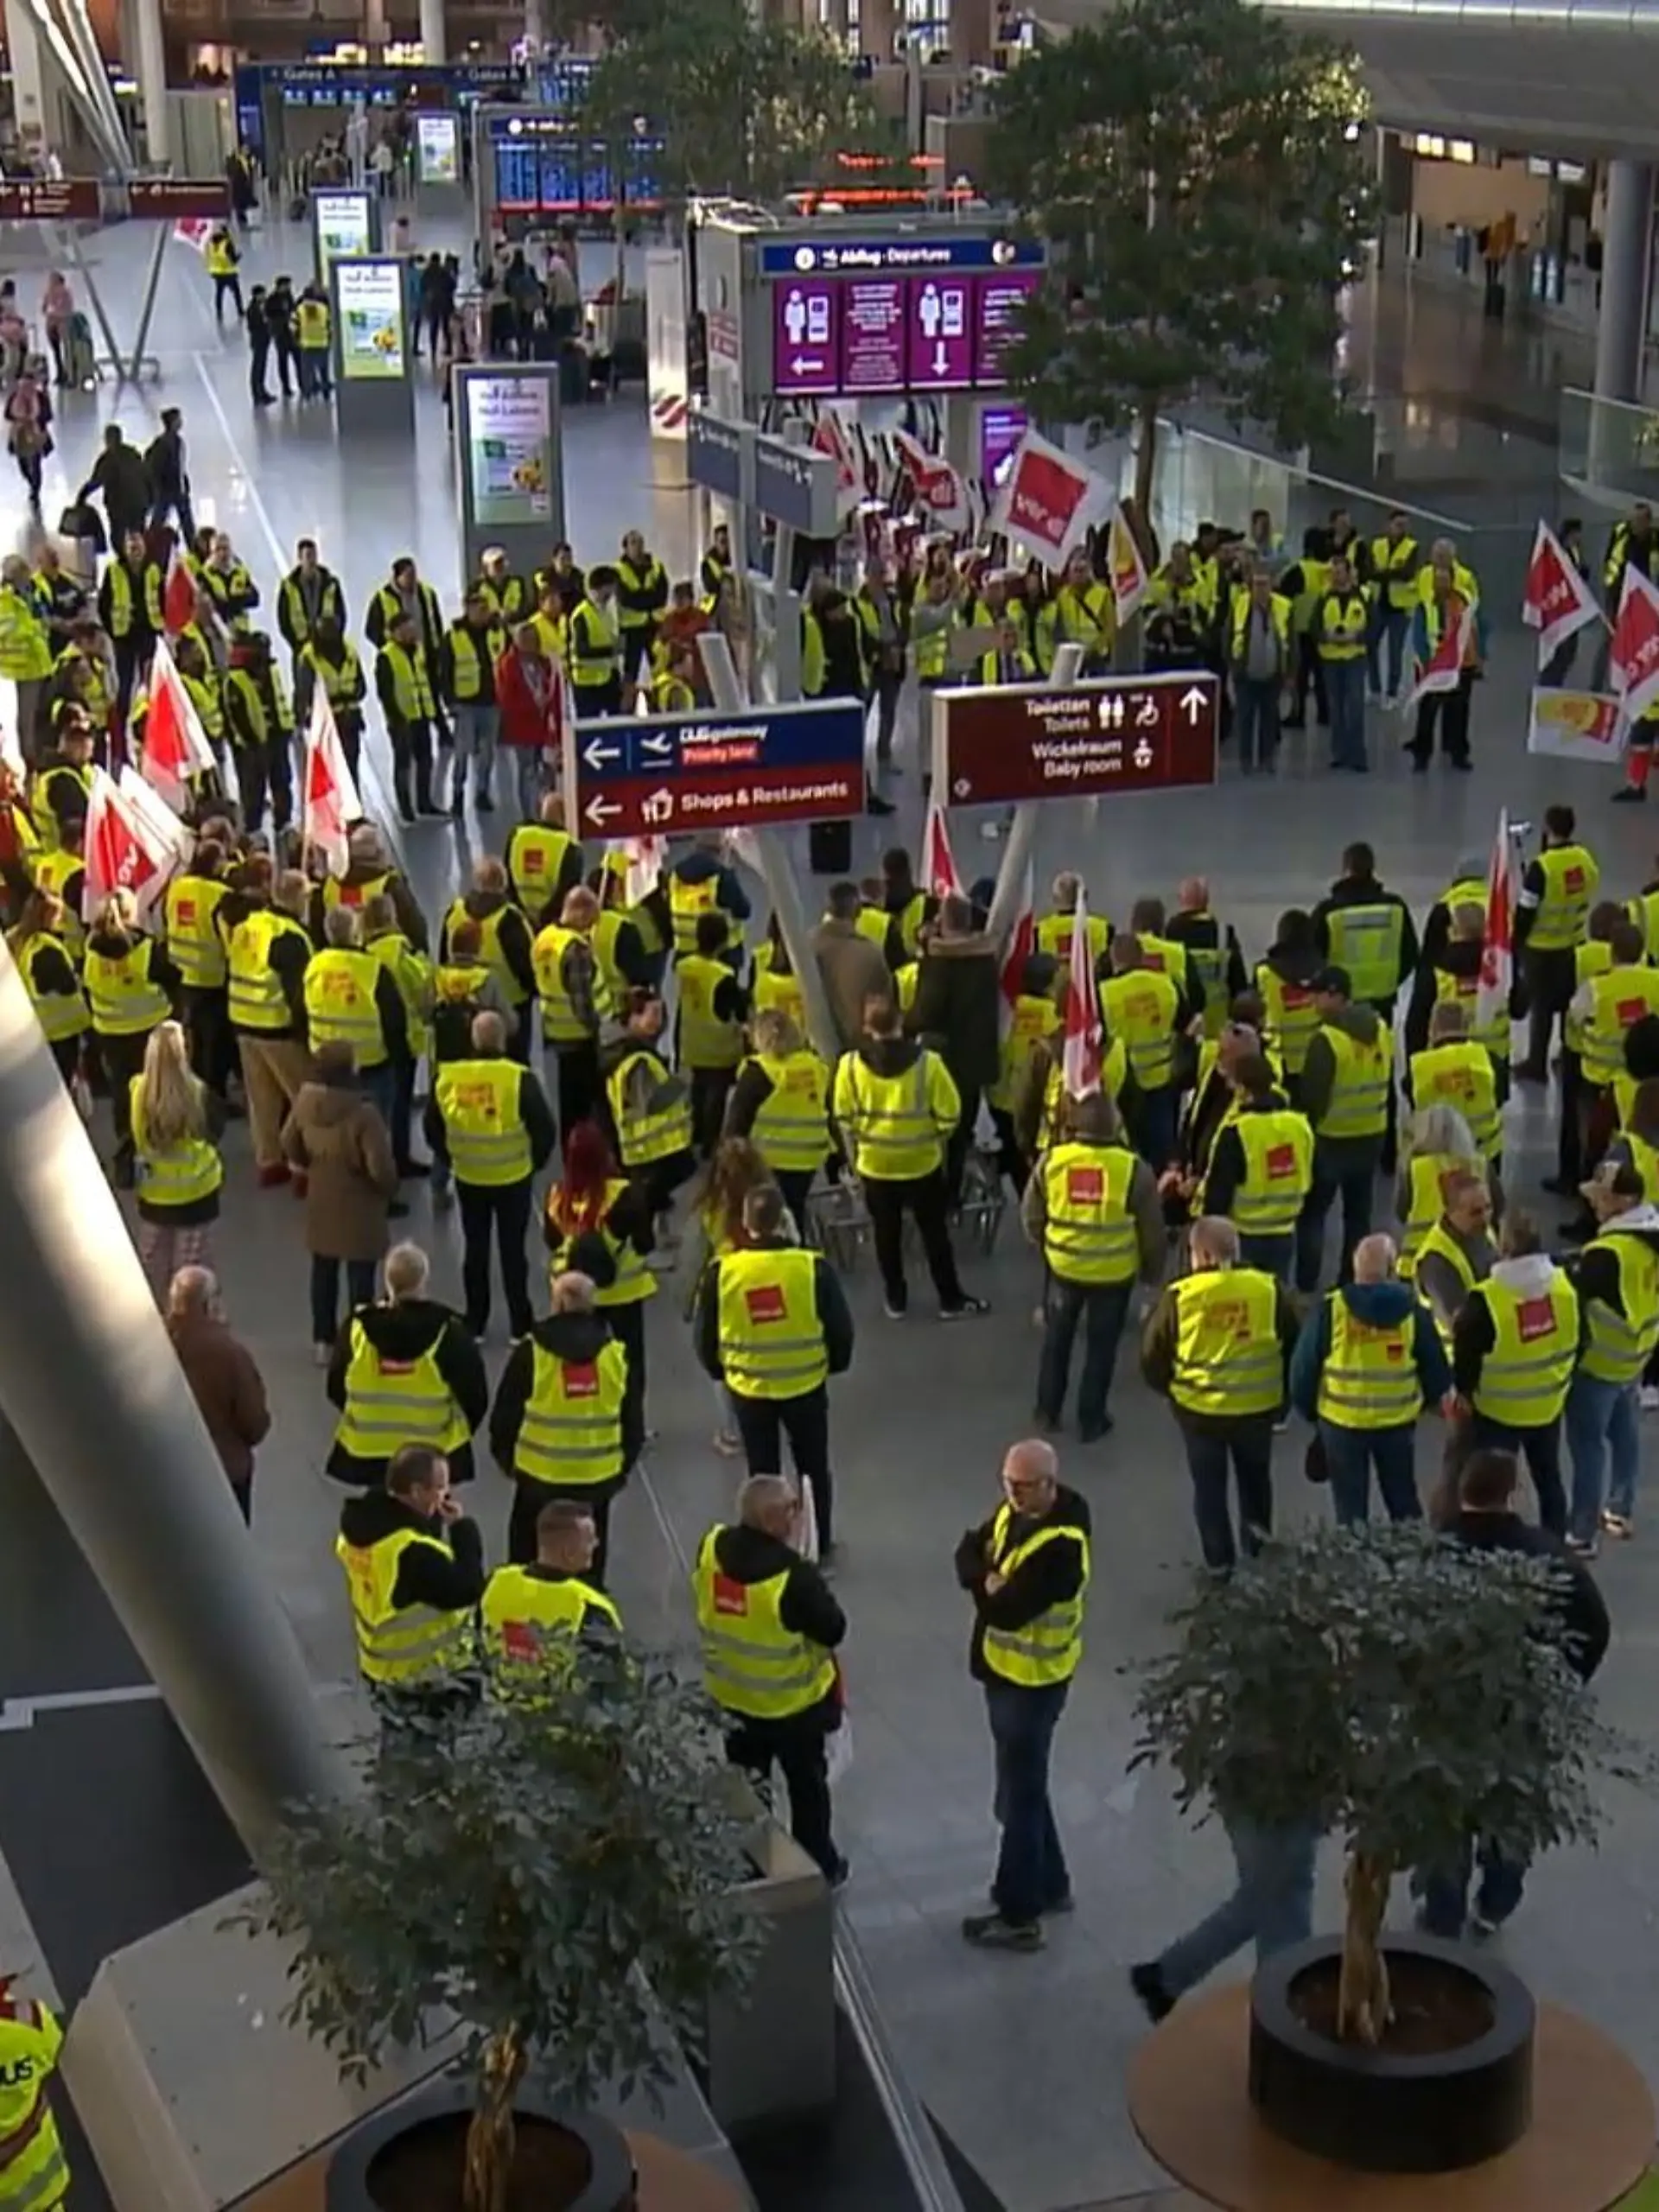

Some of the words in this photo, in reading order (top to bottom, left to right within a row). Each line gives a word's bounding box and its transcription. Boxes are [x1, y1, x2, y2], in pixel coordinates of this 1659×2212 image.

[887, 246, 950, 263] Departures
[1025, 697, 1090, 716] Toiletten
[1044, 716, 1090, 734] Toilets
[1031, 738, 1122, 760] Wickelraum
[1044, 760, 1081, 779] Baby
[1083, 759, 1122, 775] room
[681, 789, 734, 813] Shops
[736, 787, 750, 806] &
[753, 781, 848, 802] Restaurants
